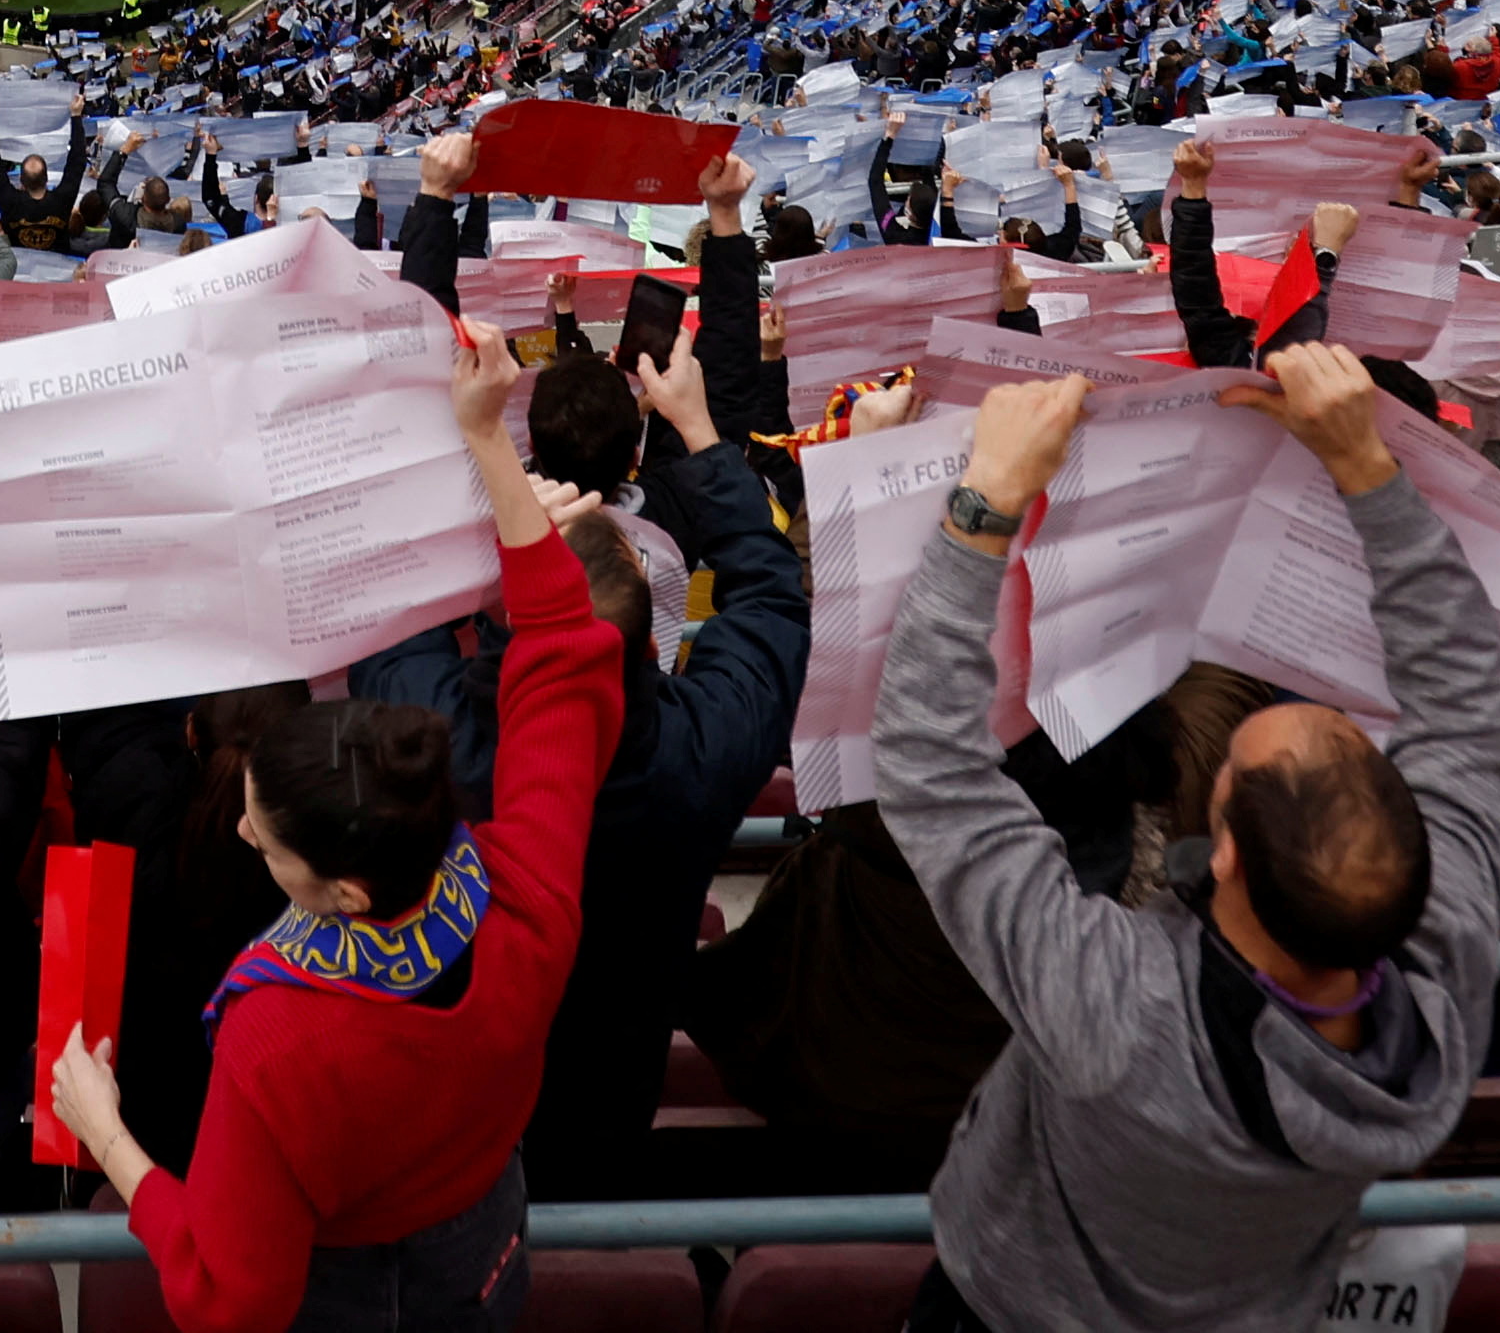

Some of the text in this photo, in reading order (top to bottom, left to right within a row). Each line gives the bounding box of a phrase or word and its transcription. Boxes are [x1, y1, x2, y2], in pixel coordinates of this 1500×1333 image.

[1240, 129, 1306, 137] FC BARCELONA
[201, 282, 222, 299] FC
[29, 352, 189, 401] FC BARCELONA
[1014, 355, 1139, 385] FC BARCELONA
[914, 461, 938, 485] FC
